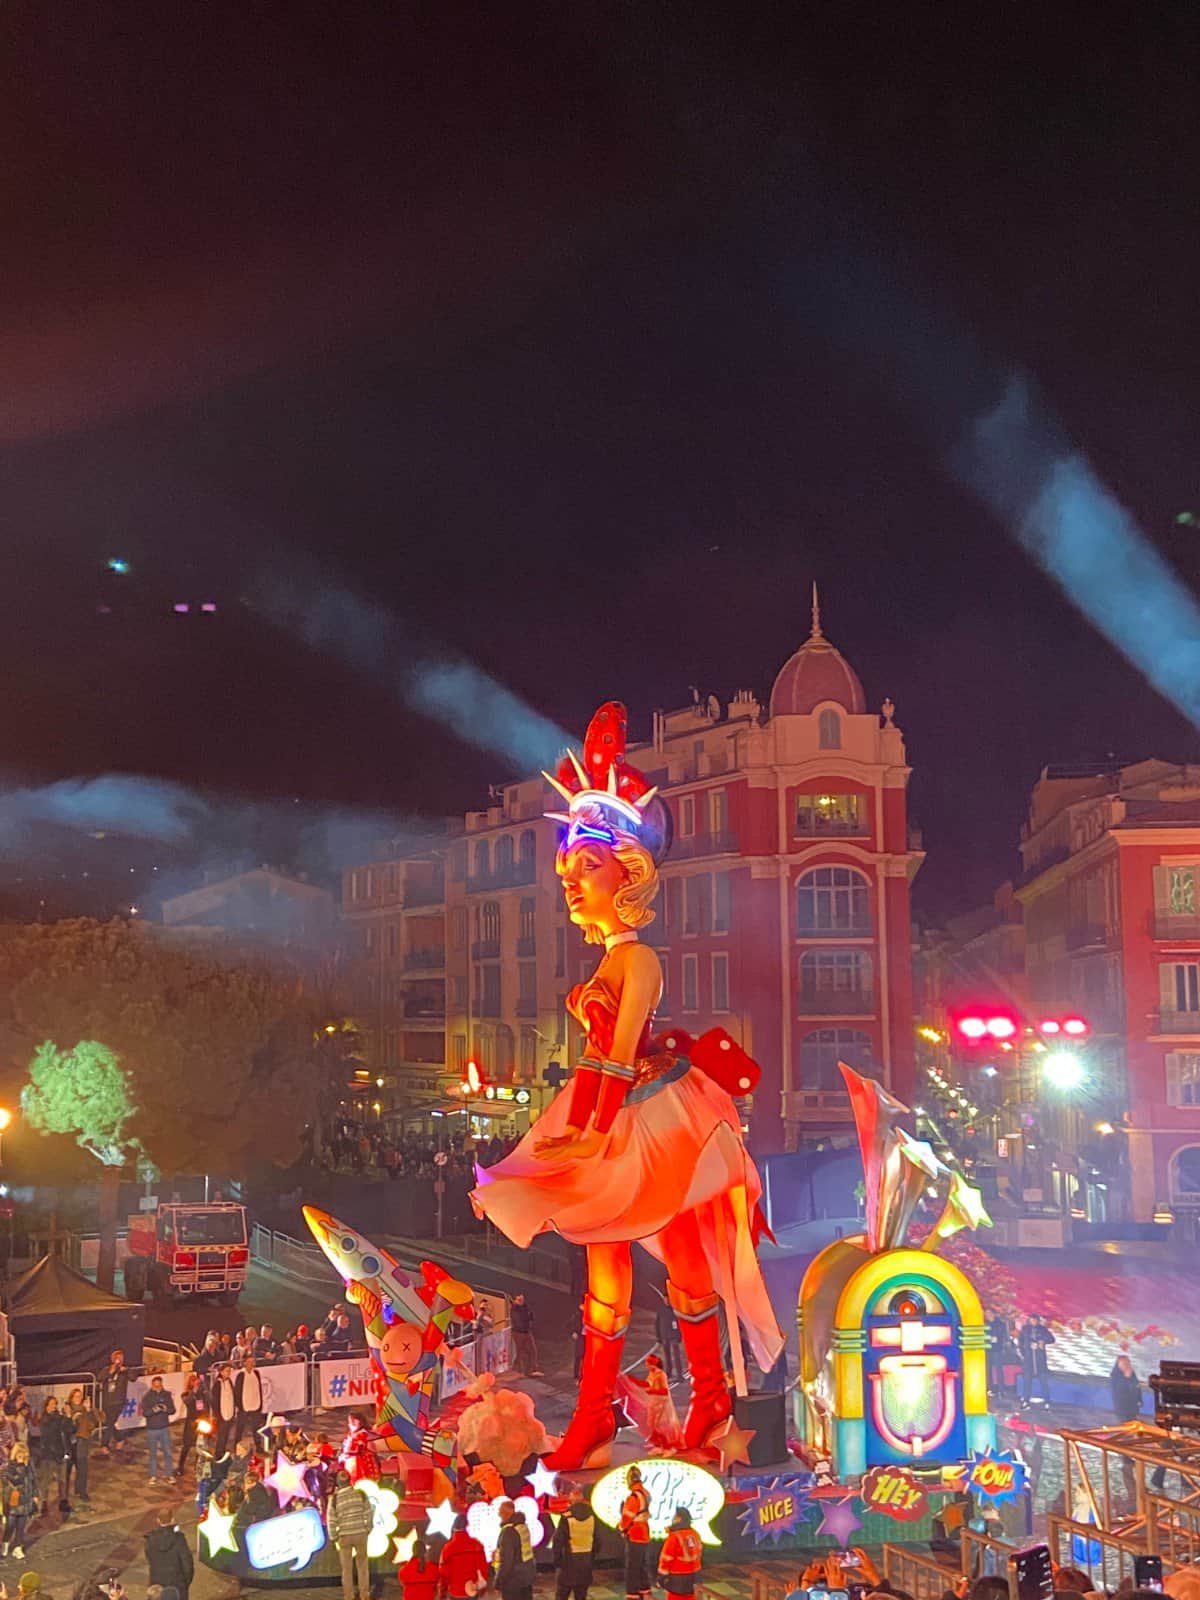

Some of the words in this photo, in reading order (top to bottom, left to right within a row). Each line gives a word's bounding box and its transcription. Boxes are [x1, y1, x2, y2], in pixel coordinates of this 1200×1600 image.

[641, 1467, 684, 1498] OP
[970, 1462, 1015, 1488] POW!
[870, 1474, 923, 1510] HEY
